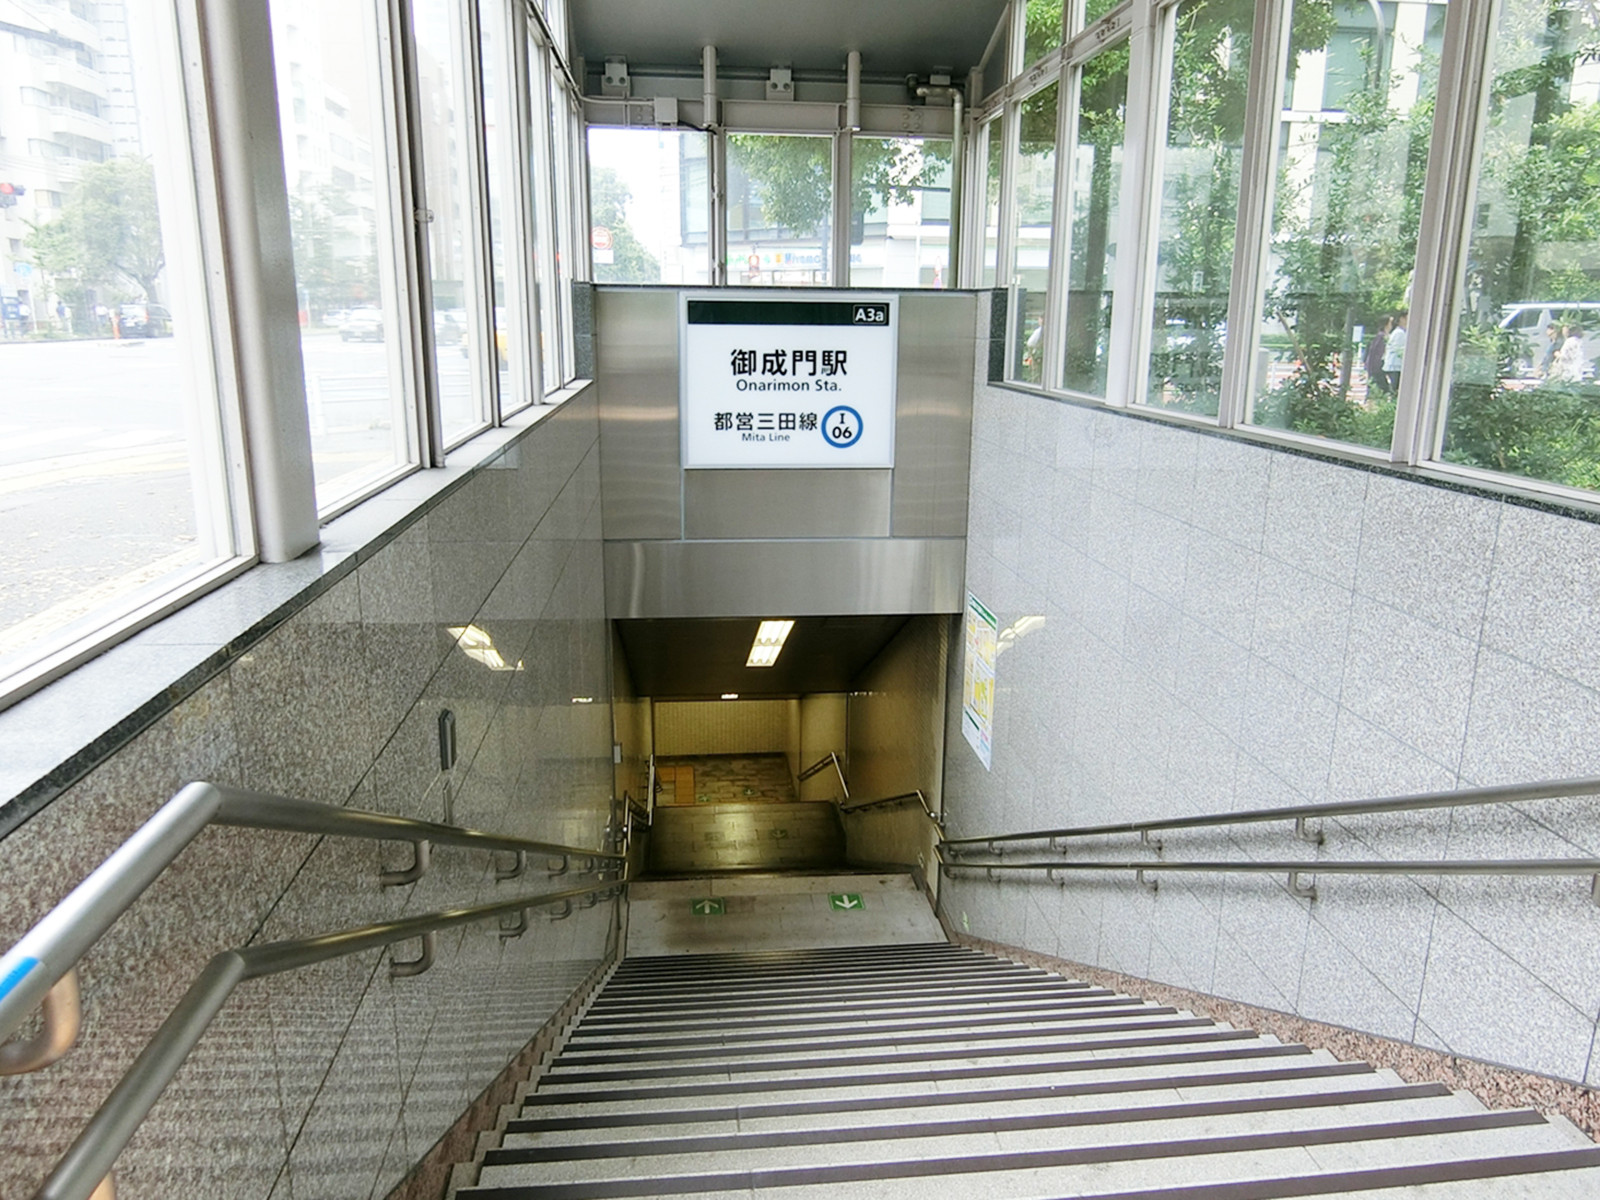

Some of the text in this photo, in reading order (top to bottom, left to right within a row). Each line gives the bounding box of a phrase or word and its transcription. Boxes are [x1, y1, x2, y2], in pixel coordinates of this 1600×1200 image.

[855, 308, 884, 322] A3a
[730, 349, 847, 376] 御成門駅
[736, 379, 842, 391] Onarimon Sta.
[714, 412, 818, 431] 都営三田線
[839, 413, 845, 424] I
[742, 433, 790, 442] Mita Line
[832, 426, 852, 439] 06
